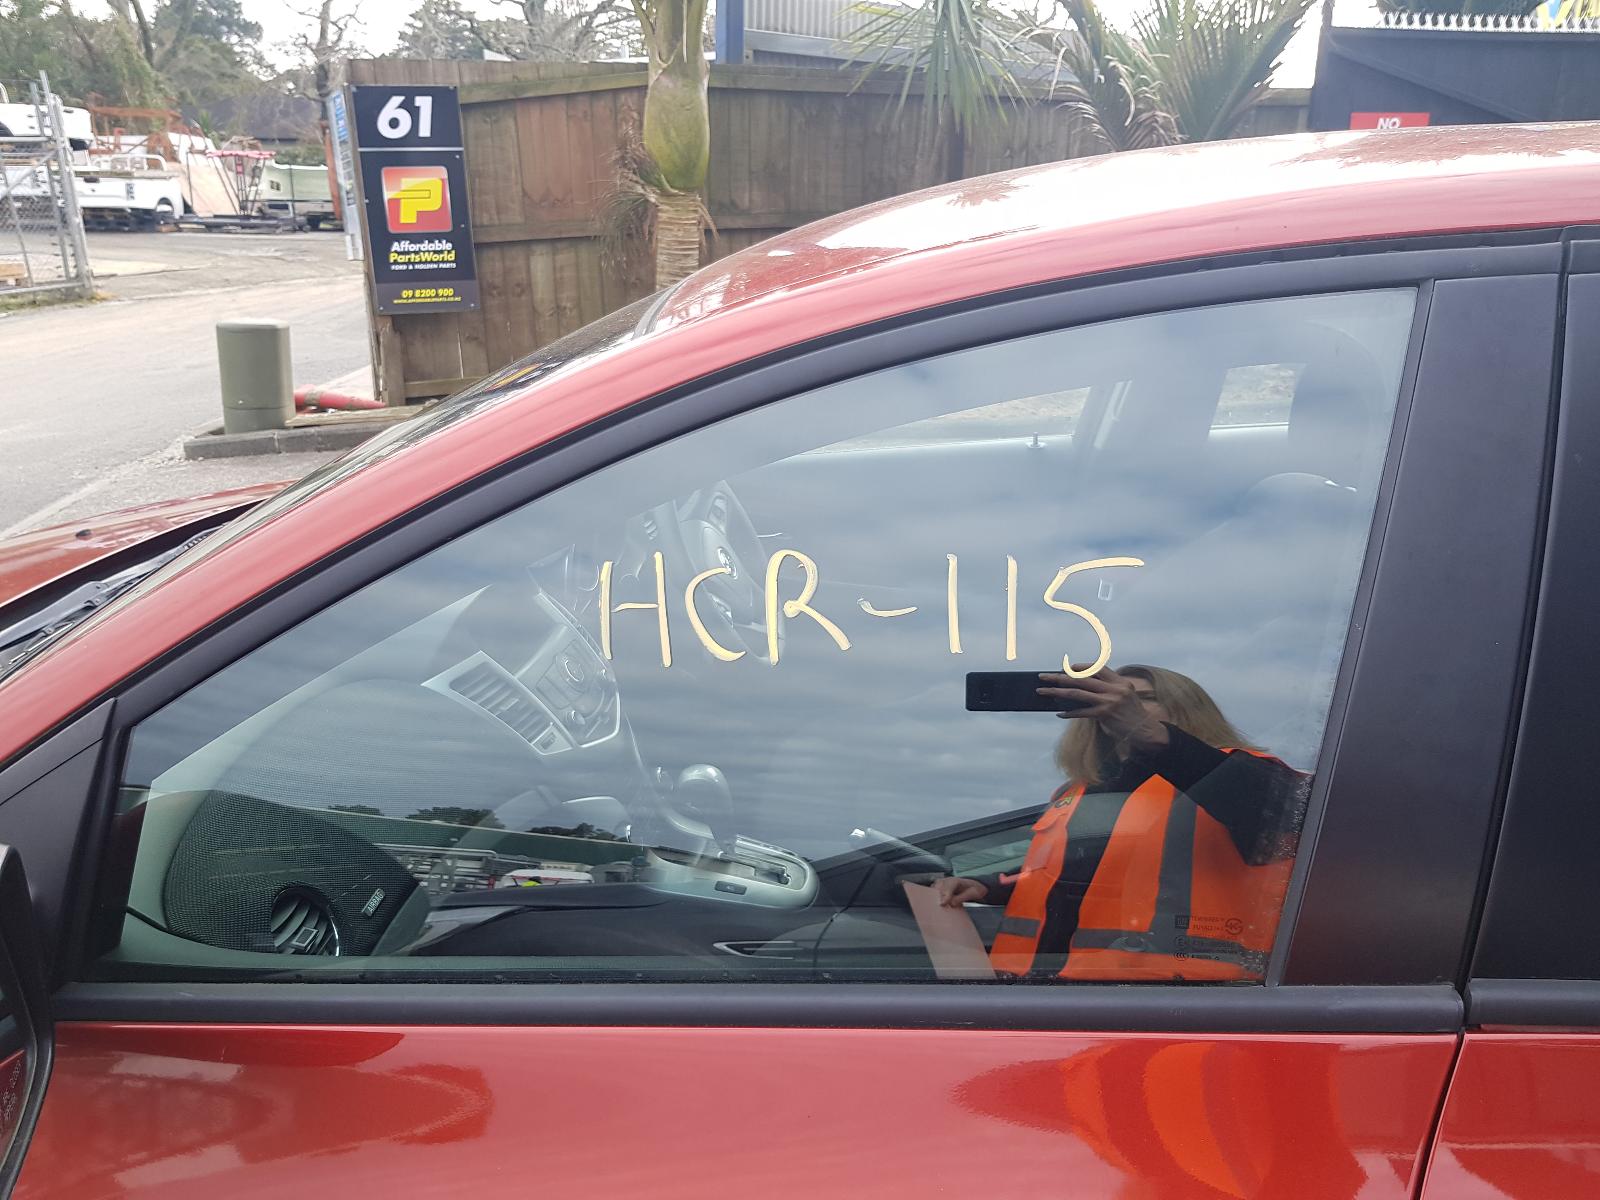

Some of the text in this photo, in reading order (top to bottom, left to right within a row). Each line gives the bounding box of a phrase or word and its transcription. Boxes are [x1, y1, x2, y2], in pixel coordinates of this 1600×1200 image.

[377, 95, 433, 139] 61
[1377, 117, 1401, 129] NO
[391, 239, 453, 252] Affordable
[389, 250, 456, 263] PartsWorld
[402, 288, 454, 298] 09 8200 900
[600, 549, 1145, 679] HCR-115
[366, 891, 384, 914] AIRBAG
